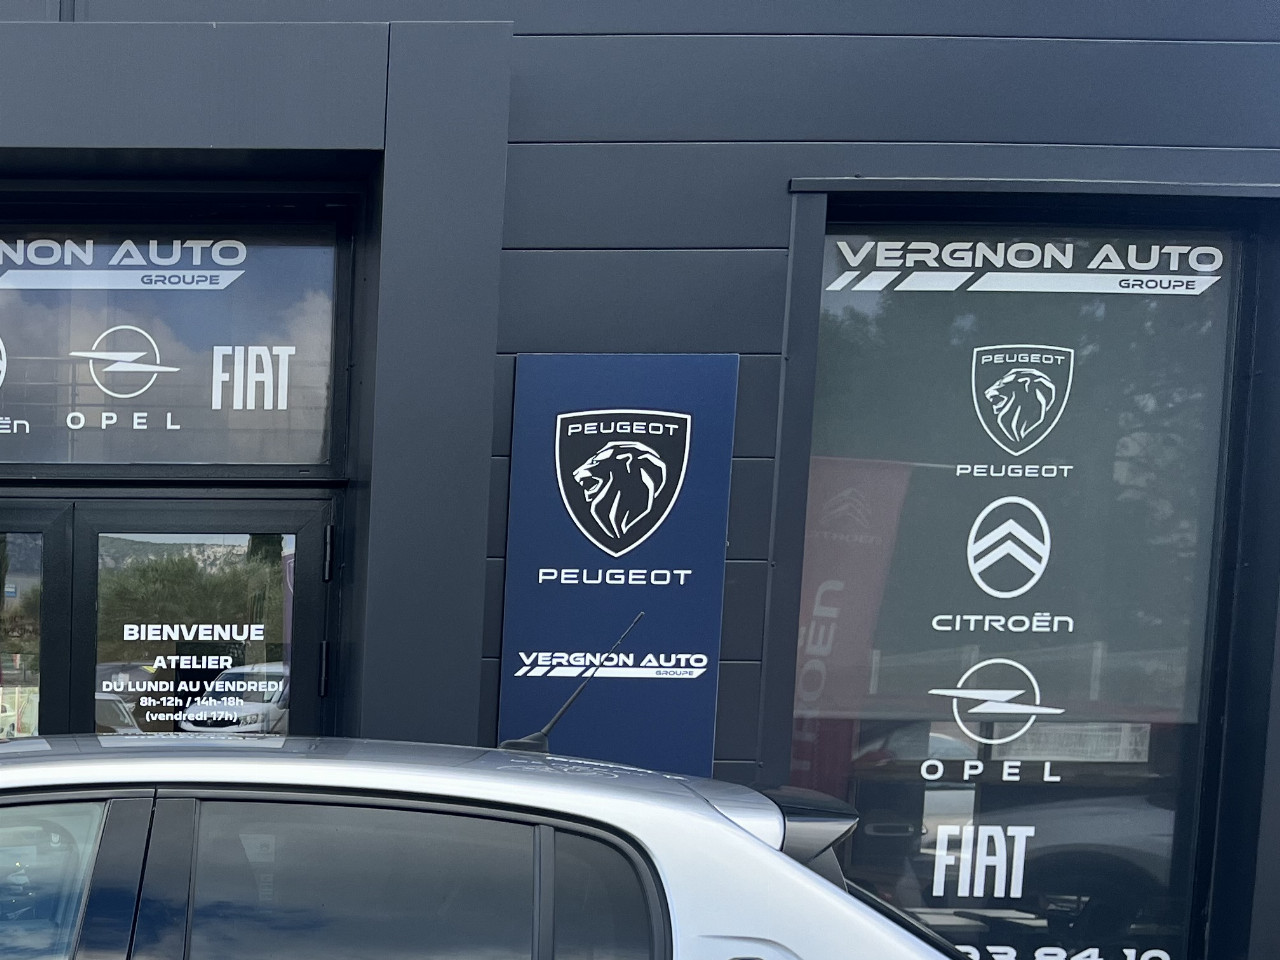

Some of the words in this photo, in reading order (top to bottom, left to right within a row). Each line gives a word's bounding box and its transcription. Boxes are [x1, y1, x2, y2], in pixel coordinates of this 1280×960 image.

[109, 240, 248, 266] AUTO
[836, 241, 1074, 269] VERGNON
[1087, 244, 1224, 272] AUTO
[140, 274, 220, 285] GROUPE
[1118, 278, 1196, 290] GROUPE
[981, 353, 1066, 365] PEUGEOT
[211, 345, 296, 410] FIAT
[66, 411, 181, 430] OPEL
[567, 421, 679, 436] PEUGEOT
[956, 464, 1074, 478] PEUGEOT
[538, 568, 693, 586] PEUGEOT
[931, 612, 1074, 633] CITROËN
[123, 623, 265, 641] BIENVENUE
[152, 655, 233, 669] ATELIER
[518, 651, 634, 667] VERGNON
[639, 653, 708, 668] AUTO
[655, 669, 694, 677] GROUPE
[102, 680, 124, 692] DU
[127, 680, 174, 692] LUNDI
[177, 680, 200, 692] AU
[203, 680, 283, 693] VENDREDI
[139, 696, 183, 707] 8h-12h
[194, 697, 244, 707] 14h-18h
[145, 711, 208, 722] (vendredi
[920, 759, 1061, 782] OPEL
[932, 825, 1036, 899] FIAT
